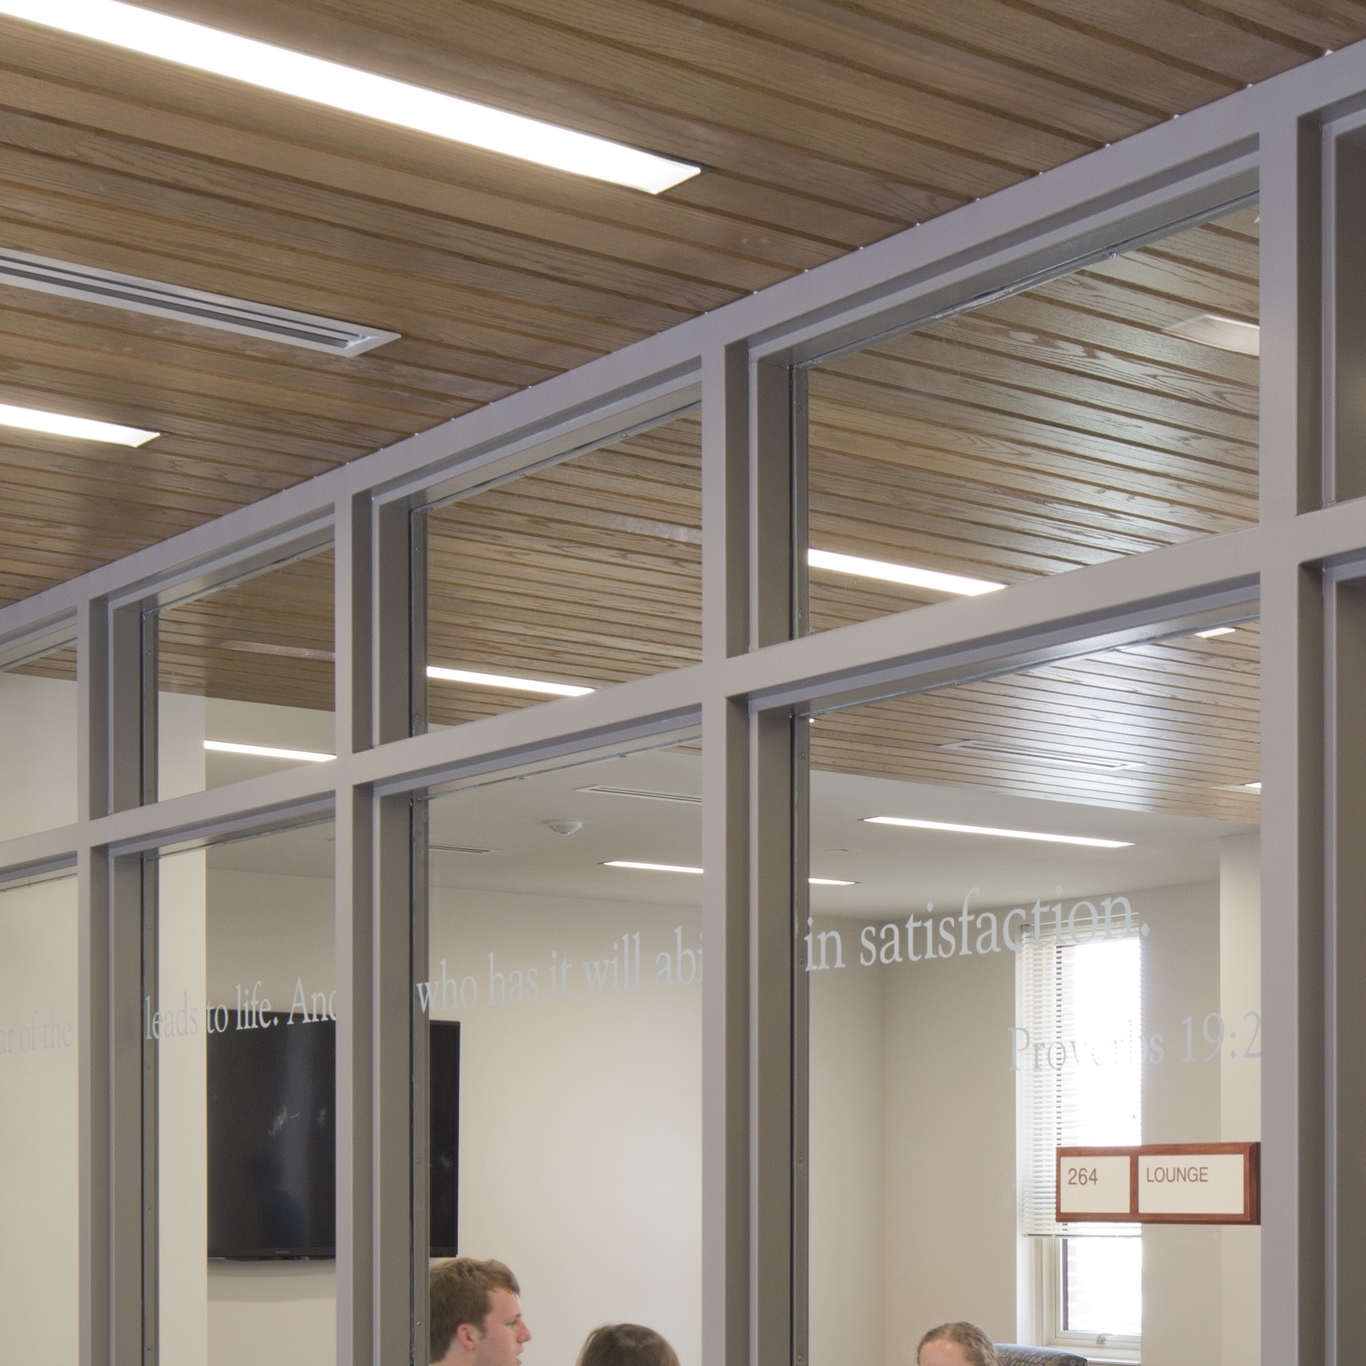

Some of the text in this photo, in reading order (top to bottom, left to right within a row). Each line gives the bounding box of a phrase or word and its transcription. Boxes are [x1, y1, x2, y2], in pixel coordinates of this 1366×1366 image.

[19, 1009, 39, 1052] of
[42, 1007, 73, 1049] the
[145, 991, 198, 1040] leads
[206, 1000, 229, 1034] to
[235, 980, 278, 1031] life.
[416, 958, 478, 1014] who
[487, 951, 539, 1005] has
[549, 950, 572, 999] it
[583, 931, 644, 995] will
[804, 916, 845, 973] in
[859, 884, 1151, 968] satisfaction.
[1067, 1167, 1099, 1186] 264
[1146, 1166, 1209, 1184] LOUNGE
